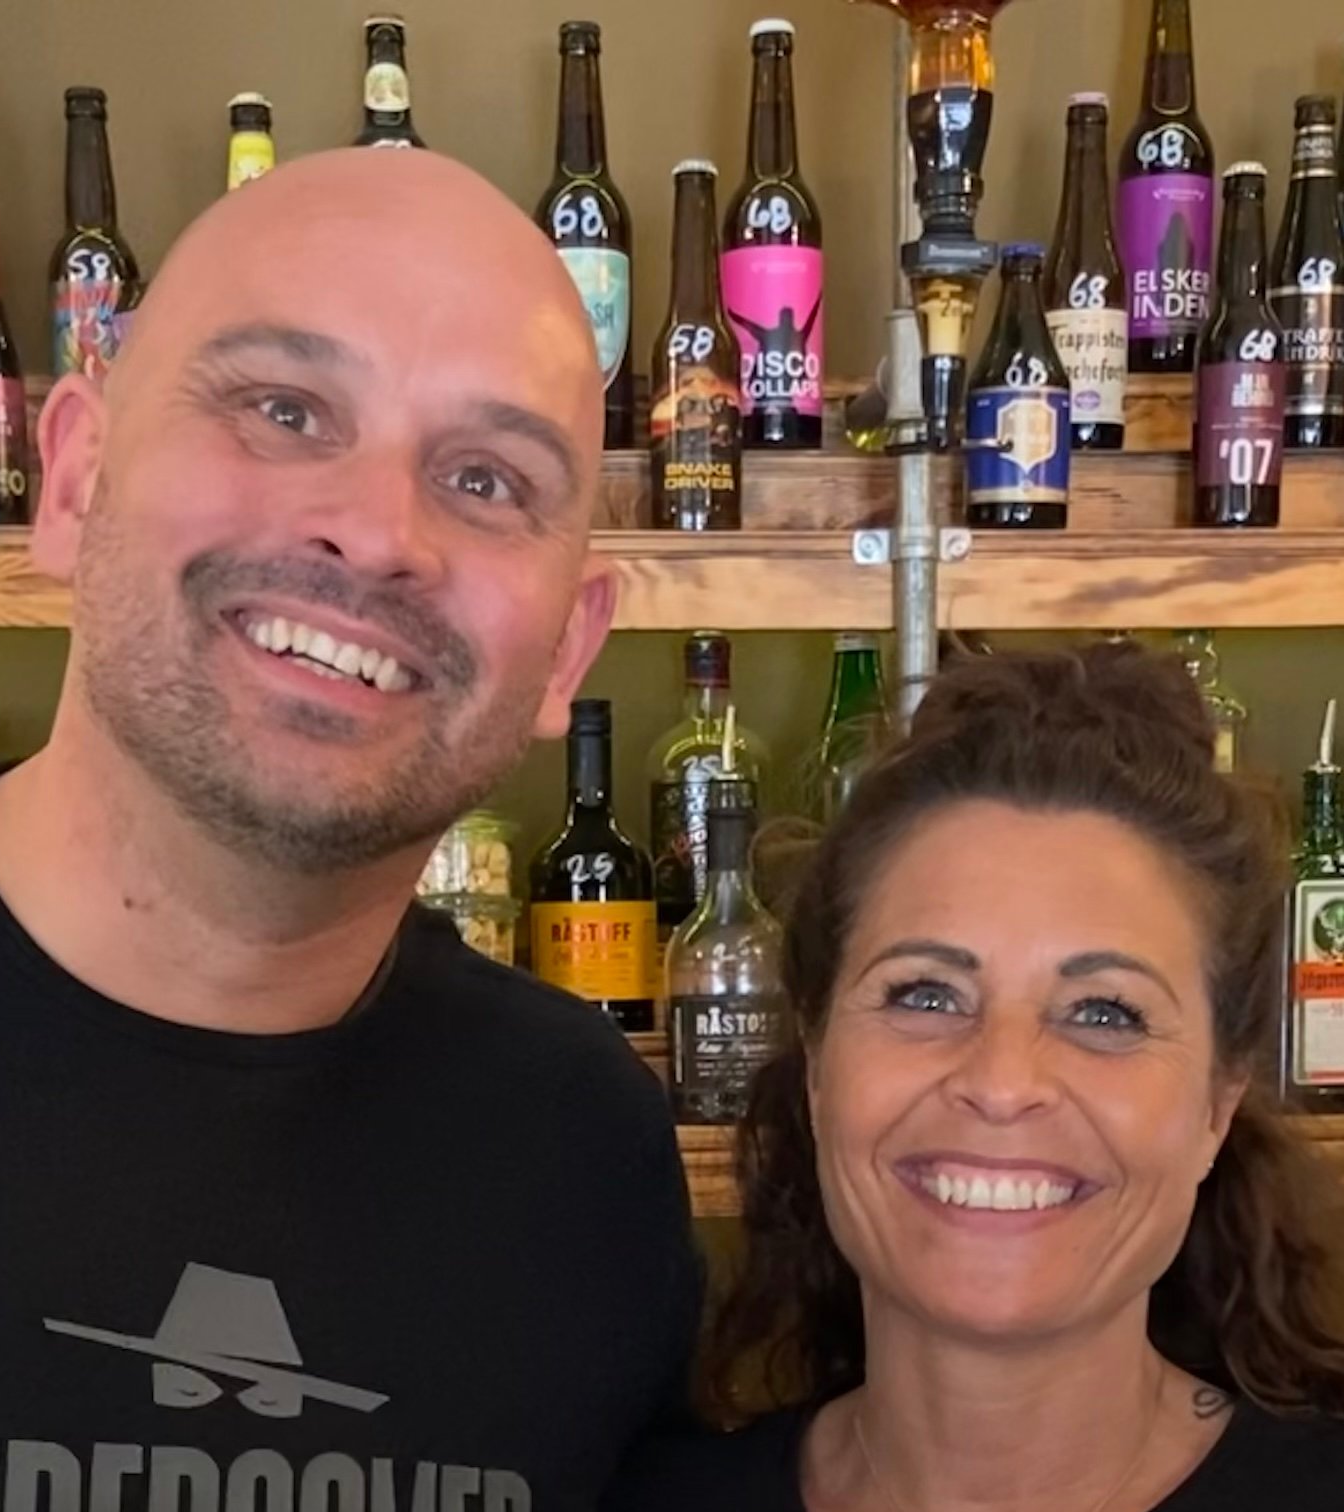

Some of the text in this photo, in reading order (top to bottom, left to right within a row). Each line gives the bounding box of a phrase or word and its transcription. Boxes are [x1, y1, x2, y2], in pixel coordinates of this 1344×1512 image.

[1136, 130, 1185, 168] 68
[553, 194, 603, 238] 68
[747, 197, 792, 234] 68
[1068, 271, 1108, 309] 68
[1297, 256, 1336, 292] 68
[667, 324, 715, 362] 68
[1240, 329, 1278, 362] 68
[740, 351, 820, 380] DISCO
[1006, 351, 1049, 388] 68
[566, 852, 615, 883] 25
